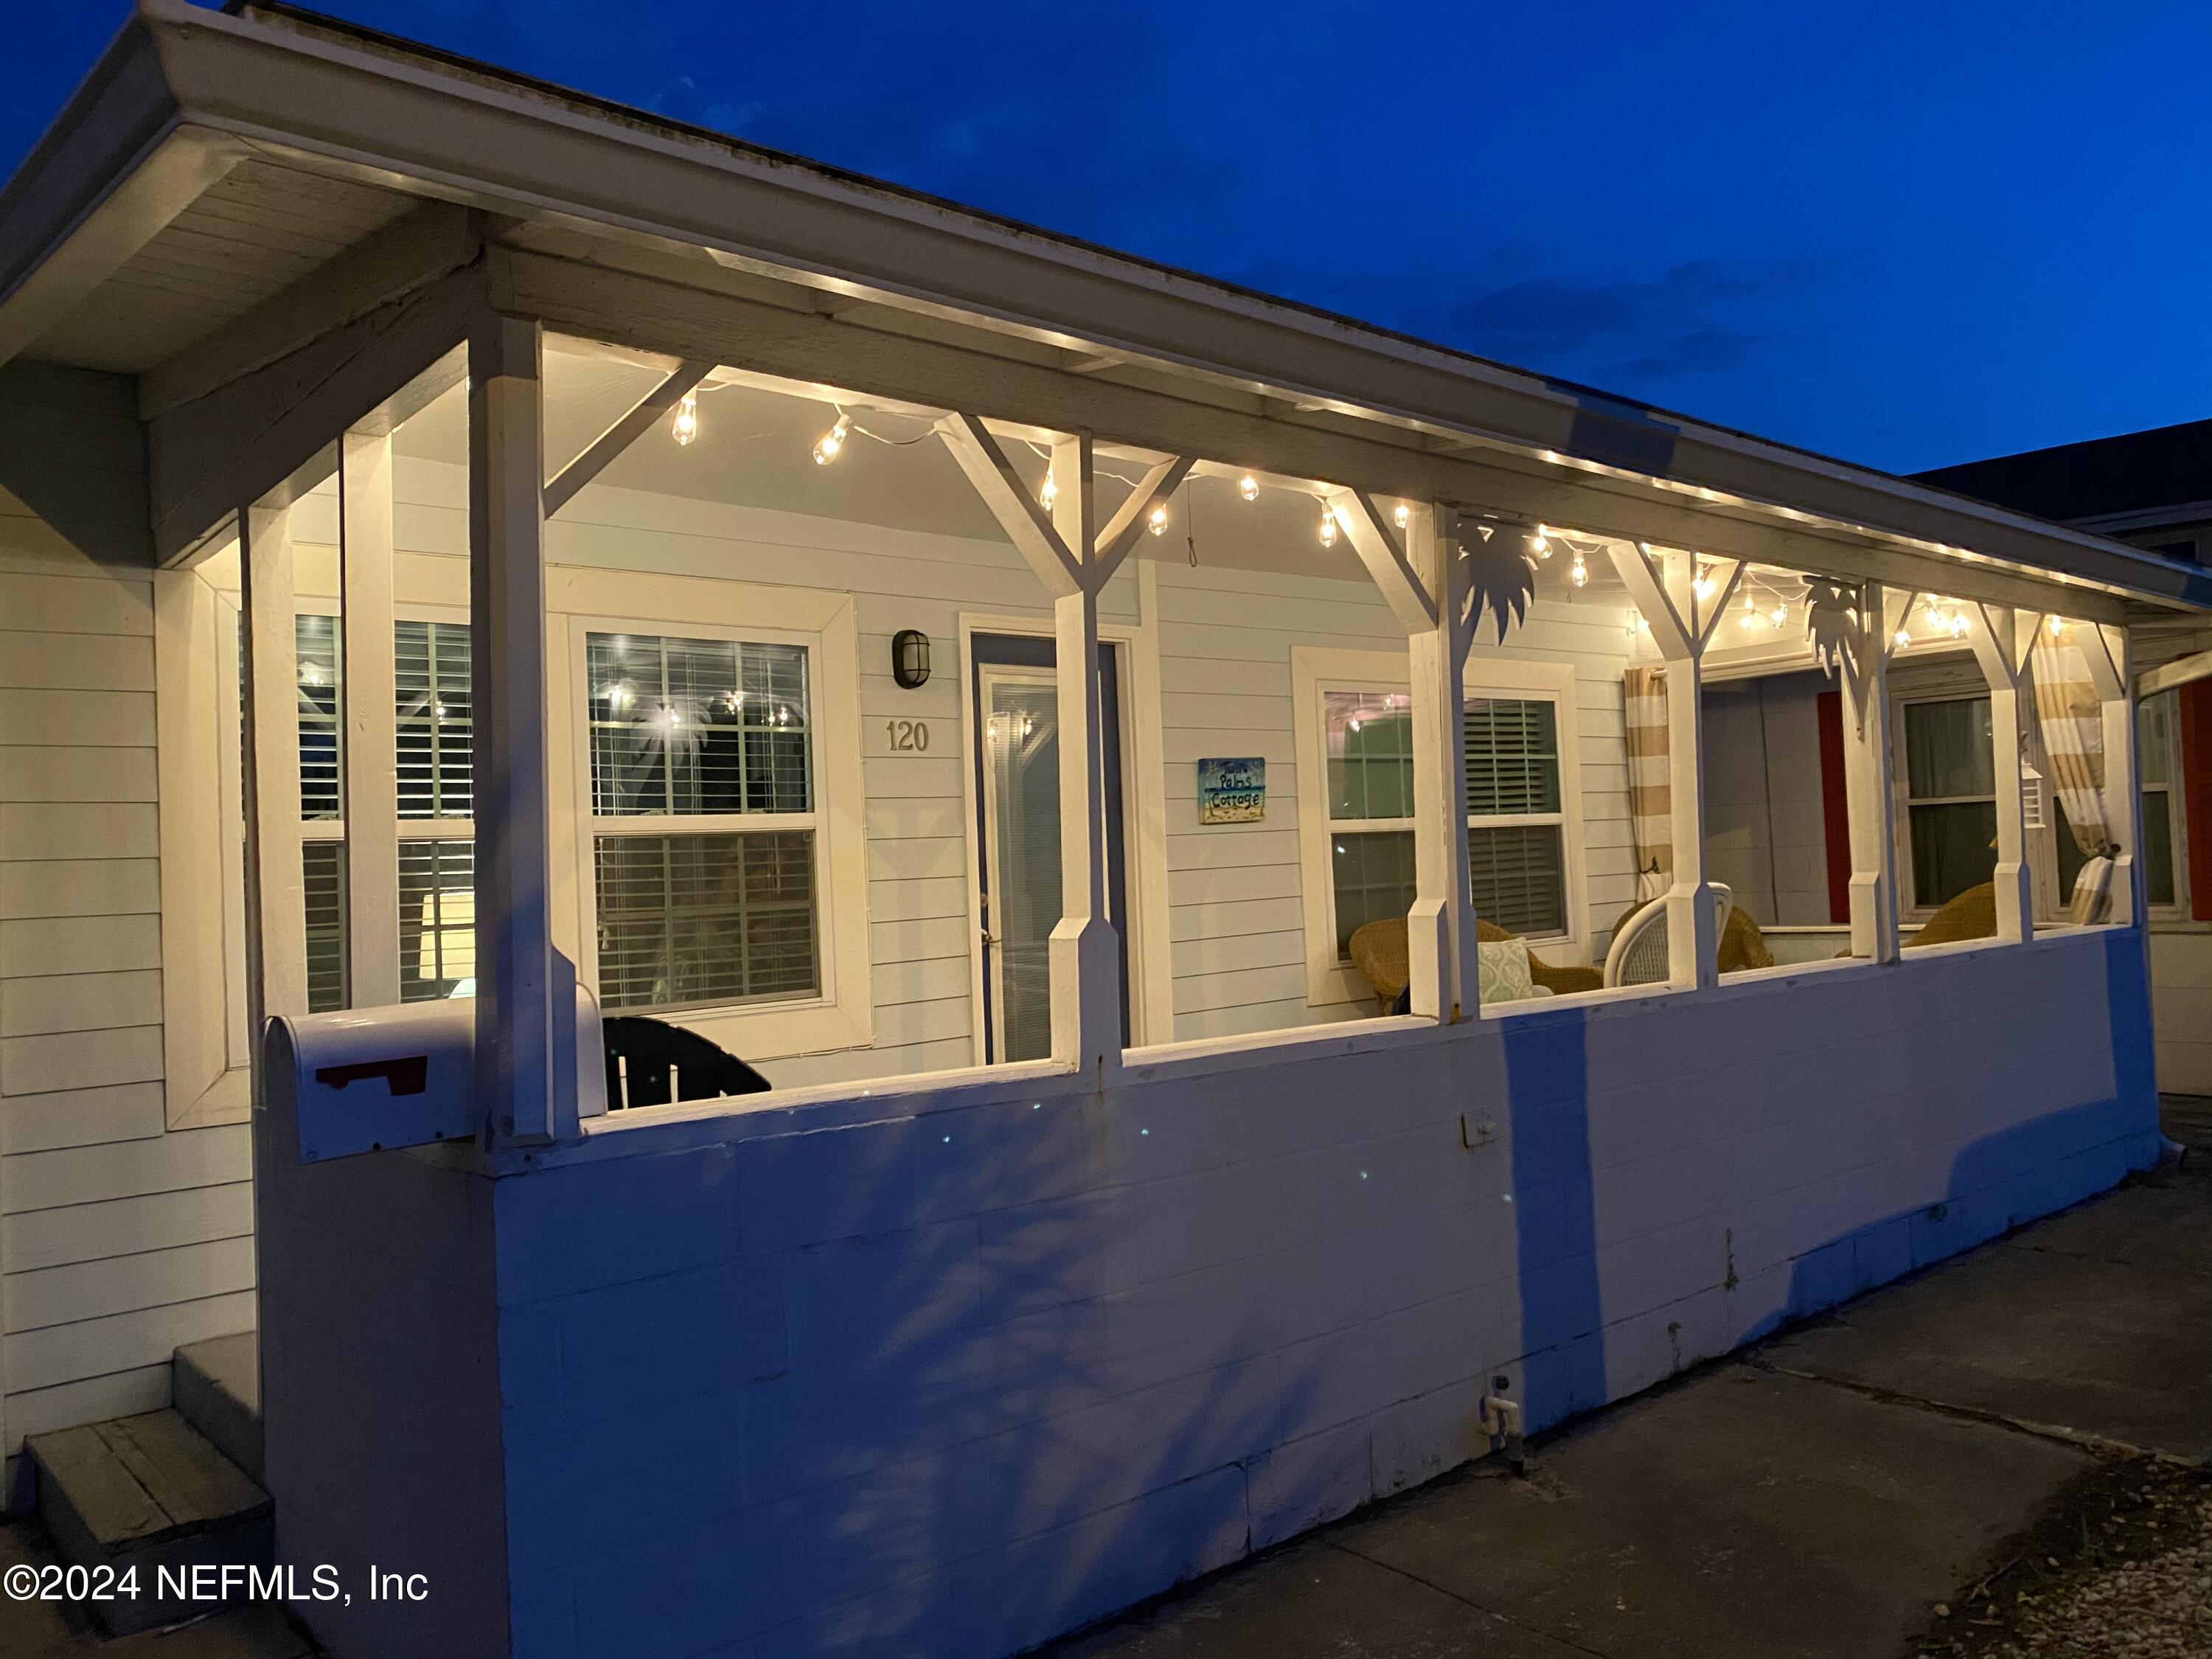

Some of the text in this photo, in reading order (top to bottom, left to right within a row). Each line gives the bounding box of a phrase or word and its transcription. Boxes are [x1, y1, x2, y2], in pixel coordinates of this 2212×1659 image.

[887, 720, 929, 751] 120
[1220, 761, 1248, 774] Twin
[1220, 774, 1251, 790] Palms
[1212, 793, 1259, 809] Cottage
